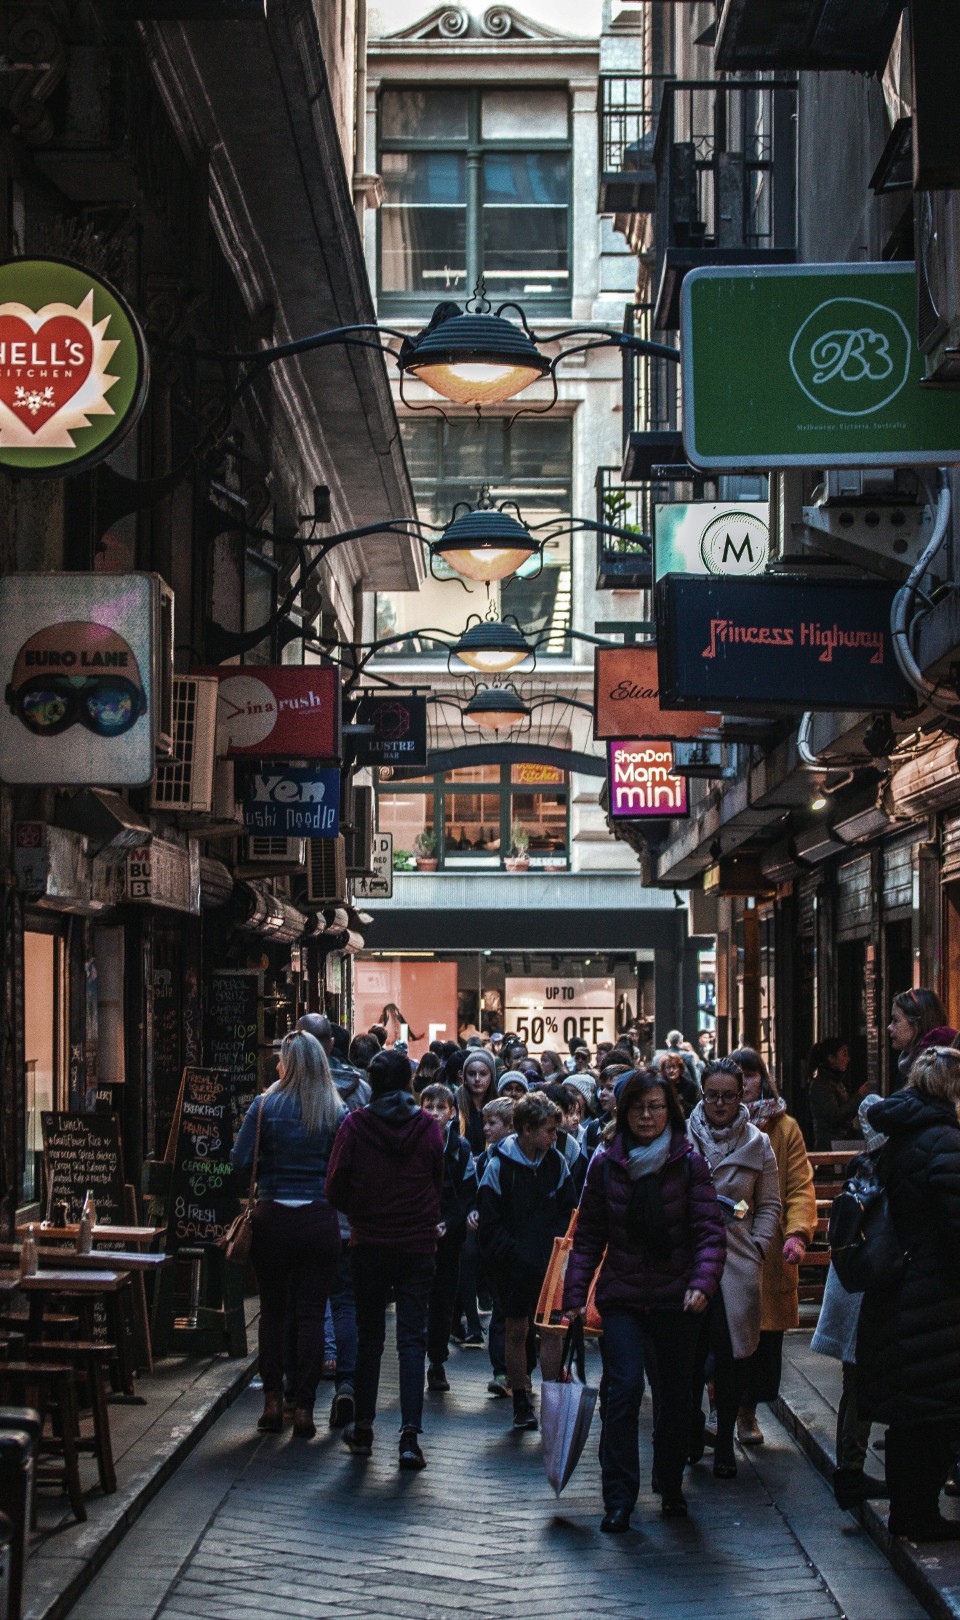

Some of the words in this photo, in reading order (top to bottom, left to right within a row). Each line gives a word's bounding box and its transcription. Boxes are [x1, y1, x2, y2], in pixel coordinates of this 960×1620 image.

[0, 369, 73, 378] ITCHEN
[701, 619, 794, 659] Princess
[800, 622, 884, 665] Highway
[25, 650, 77, 667] EURO
[80, 650, 128, 667] LANE
[280, 689, 321, 711] rush
[368, 741, 415, 751] LUSTRE
[519, 768, 559, 783] Kitchen
[252, 774, 326, 803] Yen
[616, 781, 682, 808] mini
[246, 804, 278, 828] ushi
[545, 986, 560, 1000] UP
[561, 986, 575, 1000] TO
[516, 1016, 558, 1045] 50%
[563, 1016, 604, 1045] OFF
[211, 1039, 246, 1052] BLOODY
[183, 1101, 226, 1119] BREAKFAST
[175, 1195, 186, 1218] 8
[188, 1203, 216, 1223] FRESH
[175, 1220, 231, 1239] SALADS
